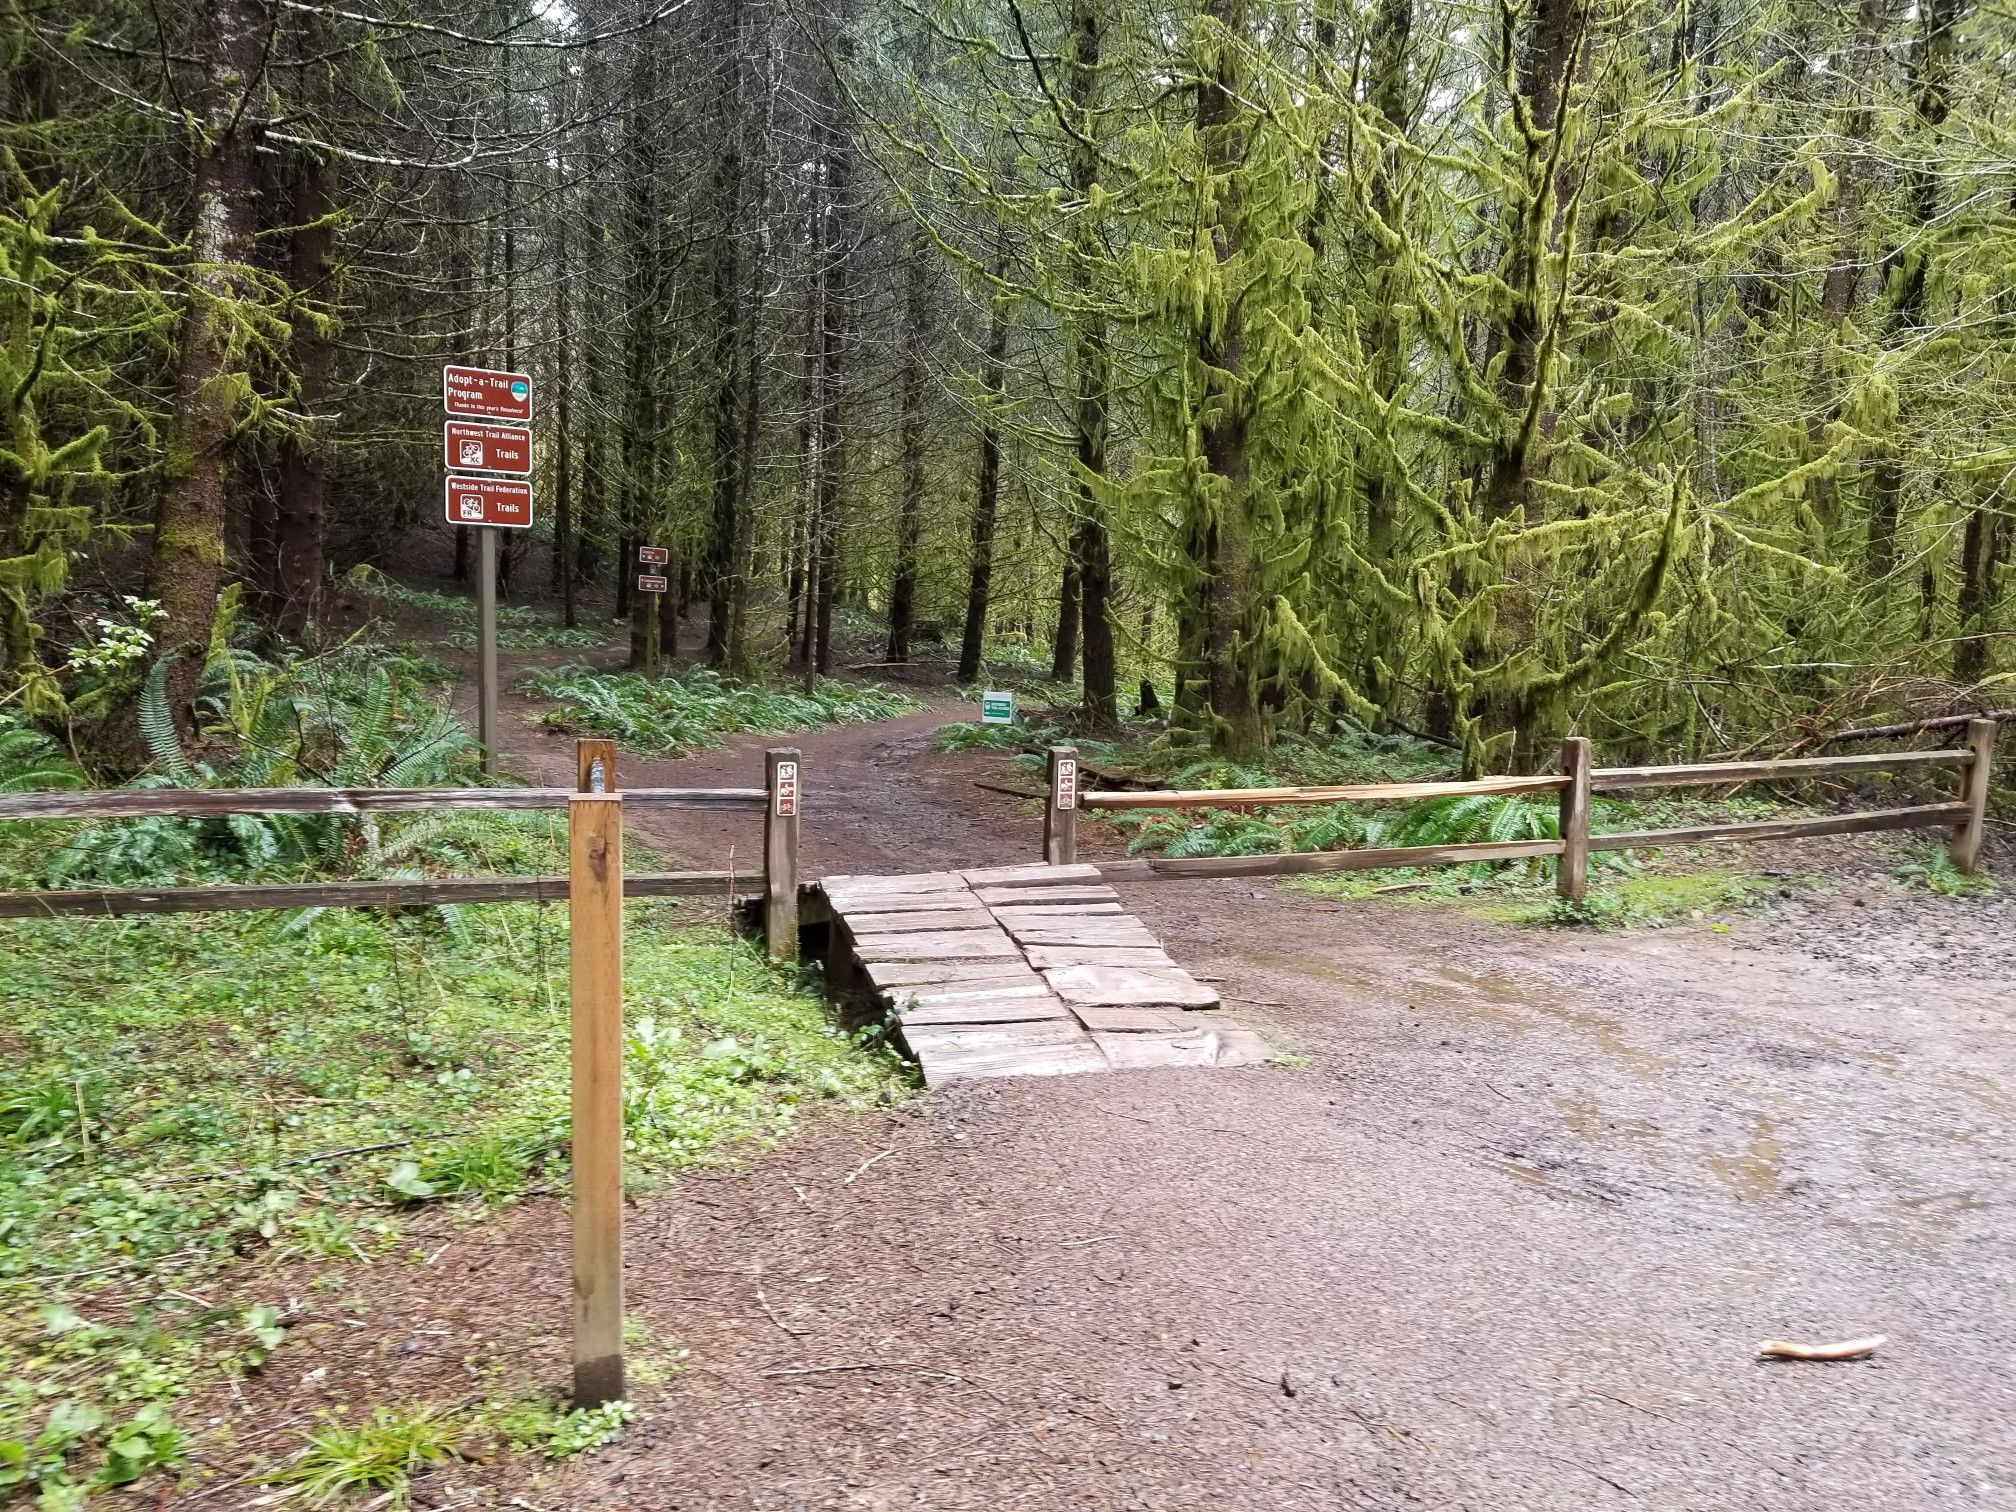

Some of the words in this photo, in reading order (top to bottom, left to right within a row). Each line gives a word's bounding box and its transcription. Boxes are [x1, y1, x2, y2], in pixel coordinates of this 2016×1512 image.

[448, 373, 508, 388] Adopt-a-Trail
[448, 387, 482, 400] Program
[452, 428, 484, 438] Northwest
[486, 430, 500, 438] Trail
[502, 432, 526, 440] Alliance
[496, 448, 519, 460] Trails
[451, 482, 478, 491] Westside
[496, 486, 528, 494] Federation
[496, 502, 520, 512] Trails
